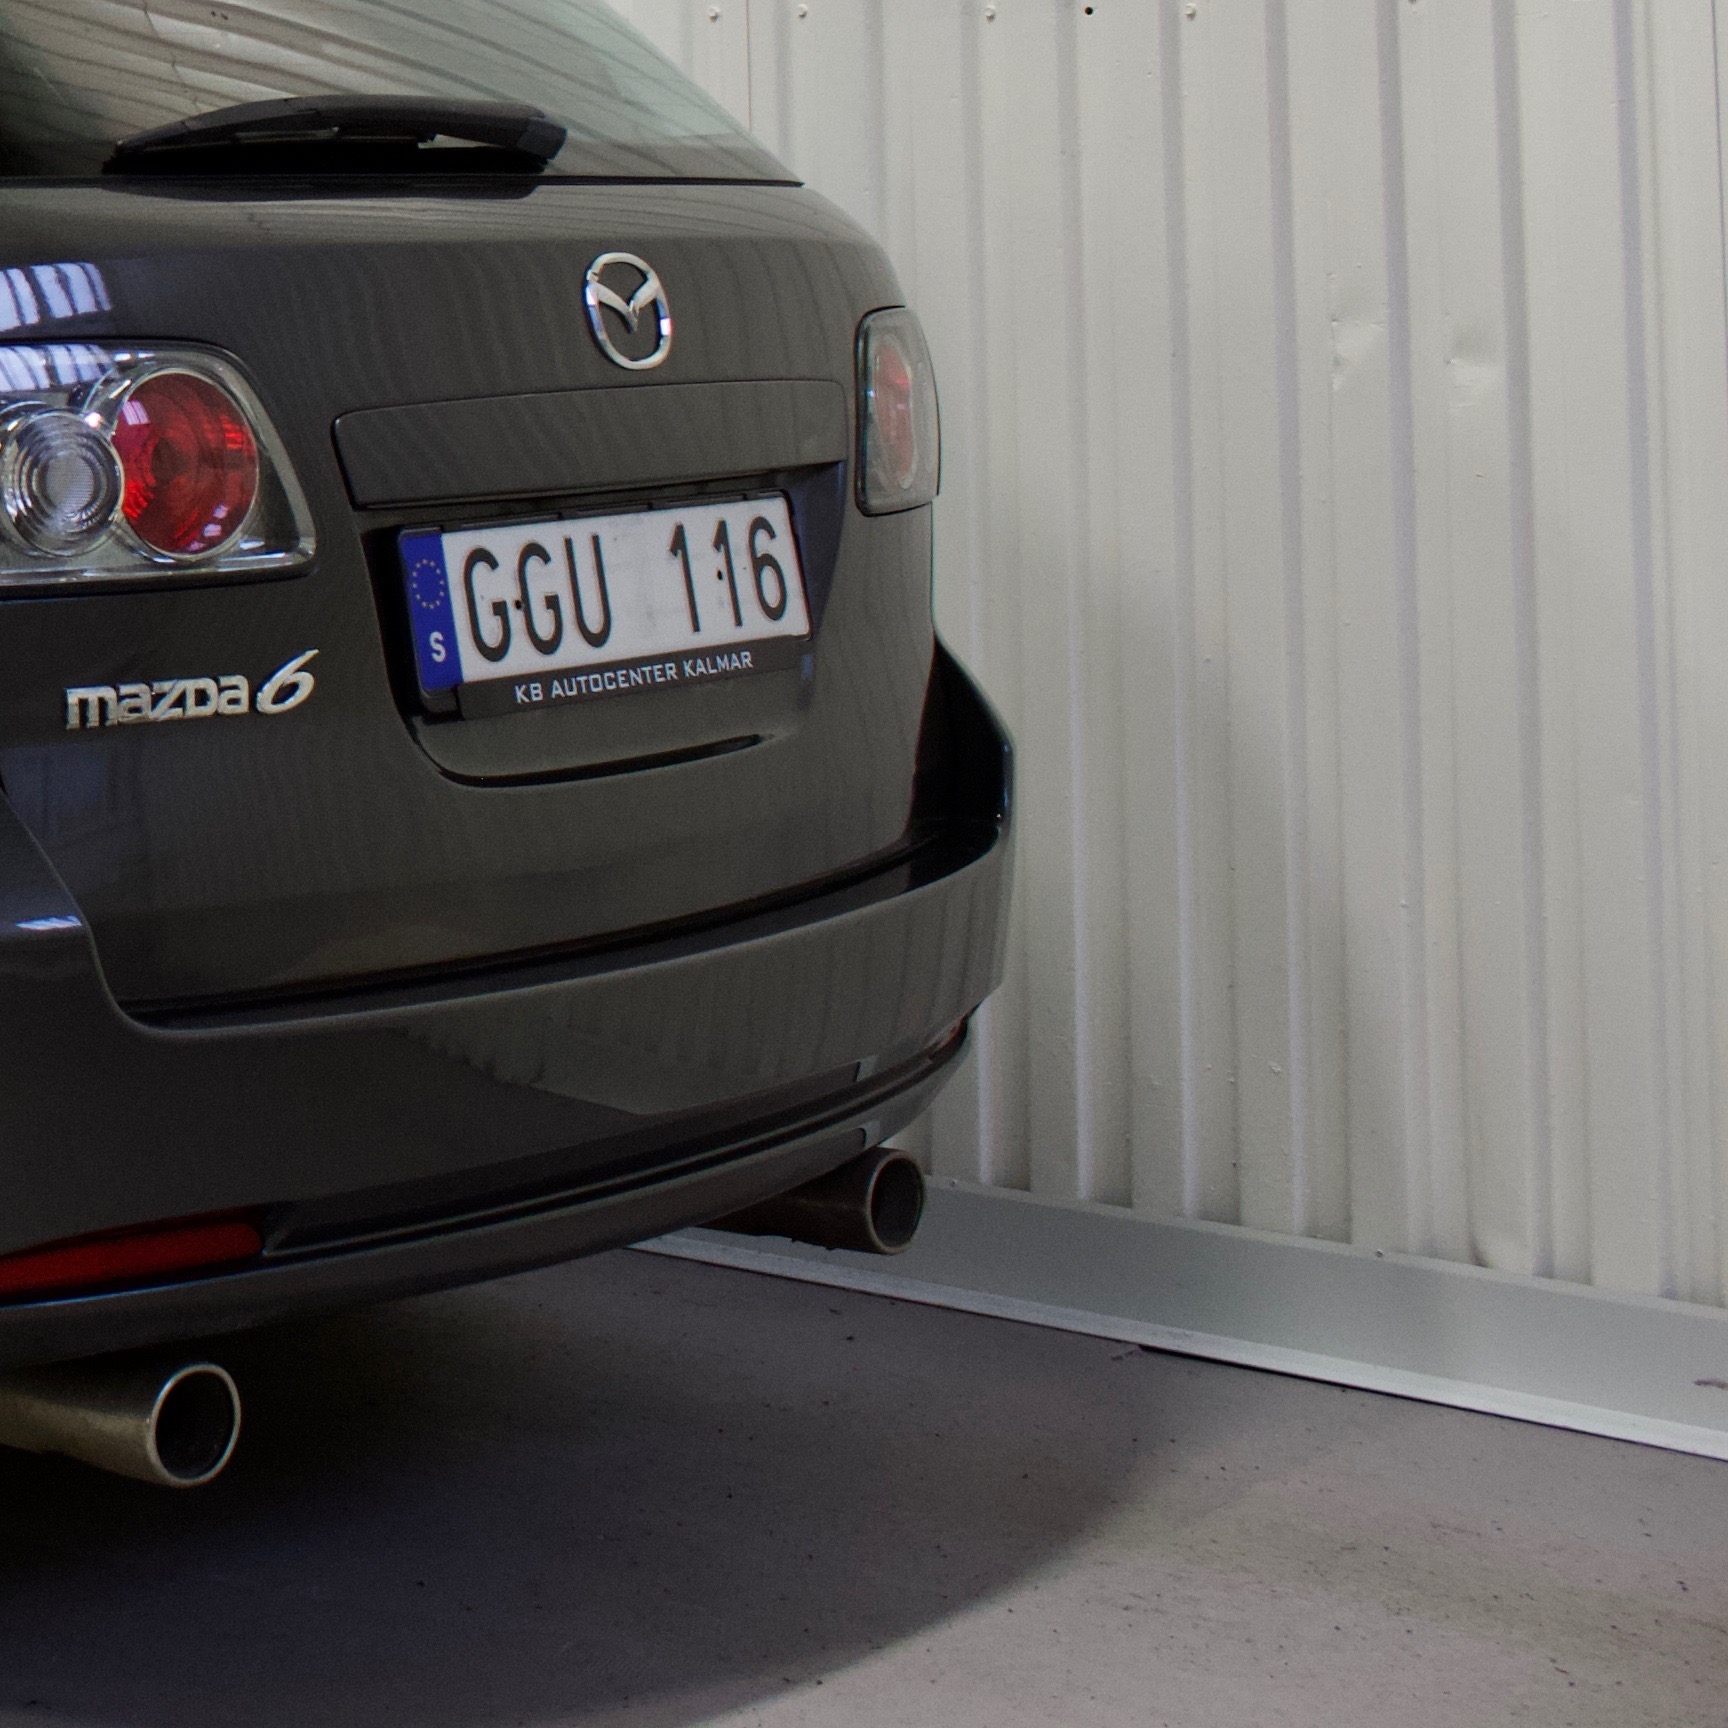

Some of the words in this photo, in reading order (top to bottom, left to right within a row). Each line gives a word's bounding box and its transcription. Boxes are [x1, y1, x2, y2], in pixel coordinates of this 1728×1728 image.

[463, 534, 611, 663] GGU
[669, 516, 787, 633] 116
[429, 631, 446, 663] S
[515, 682, 543, 704] KB
[551, 661, 678, 699] AUTOCENTER
[683, 650, 753, 678] KALMAR
